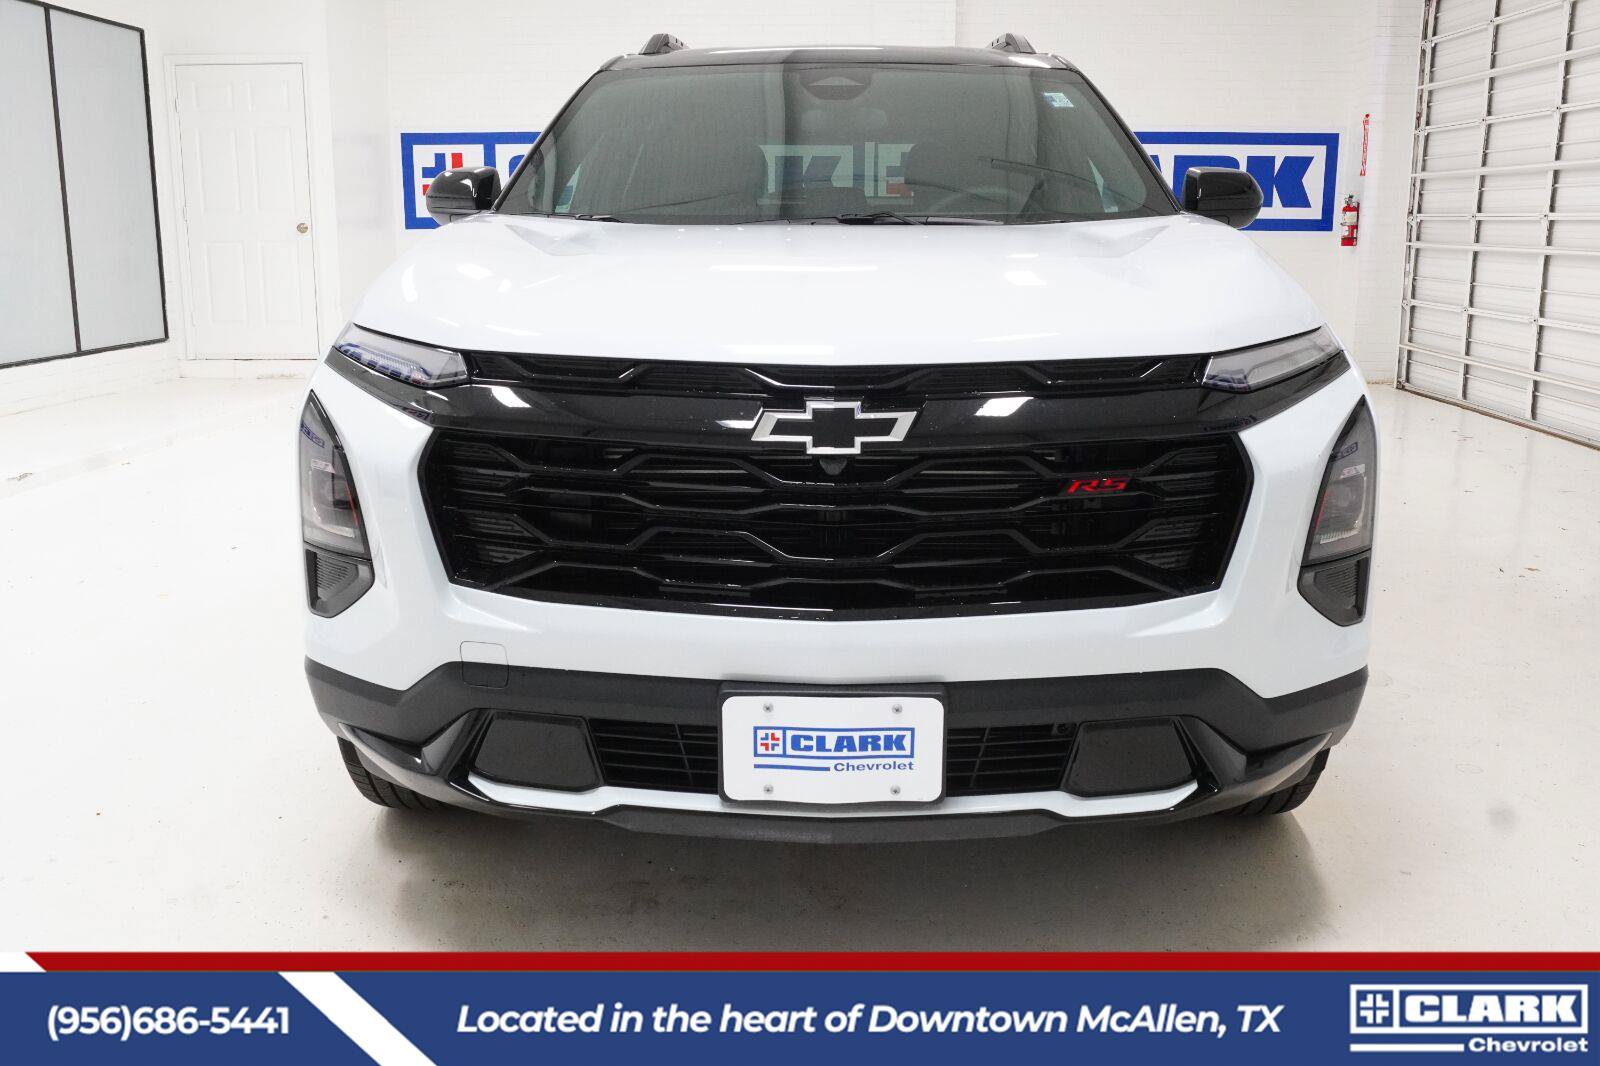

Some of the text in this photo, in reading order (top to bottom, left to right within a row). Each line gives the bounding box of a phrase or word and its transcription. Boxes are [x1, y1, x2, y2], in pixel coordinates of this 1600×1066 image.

[1066, 477, 1129, 494] RS
[790, 733, 907, 753] CLARK
[833, 760, 914, 772] Chevrolet
